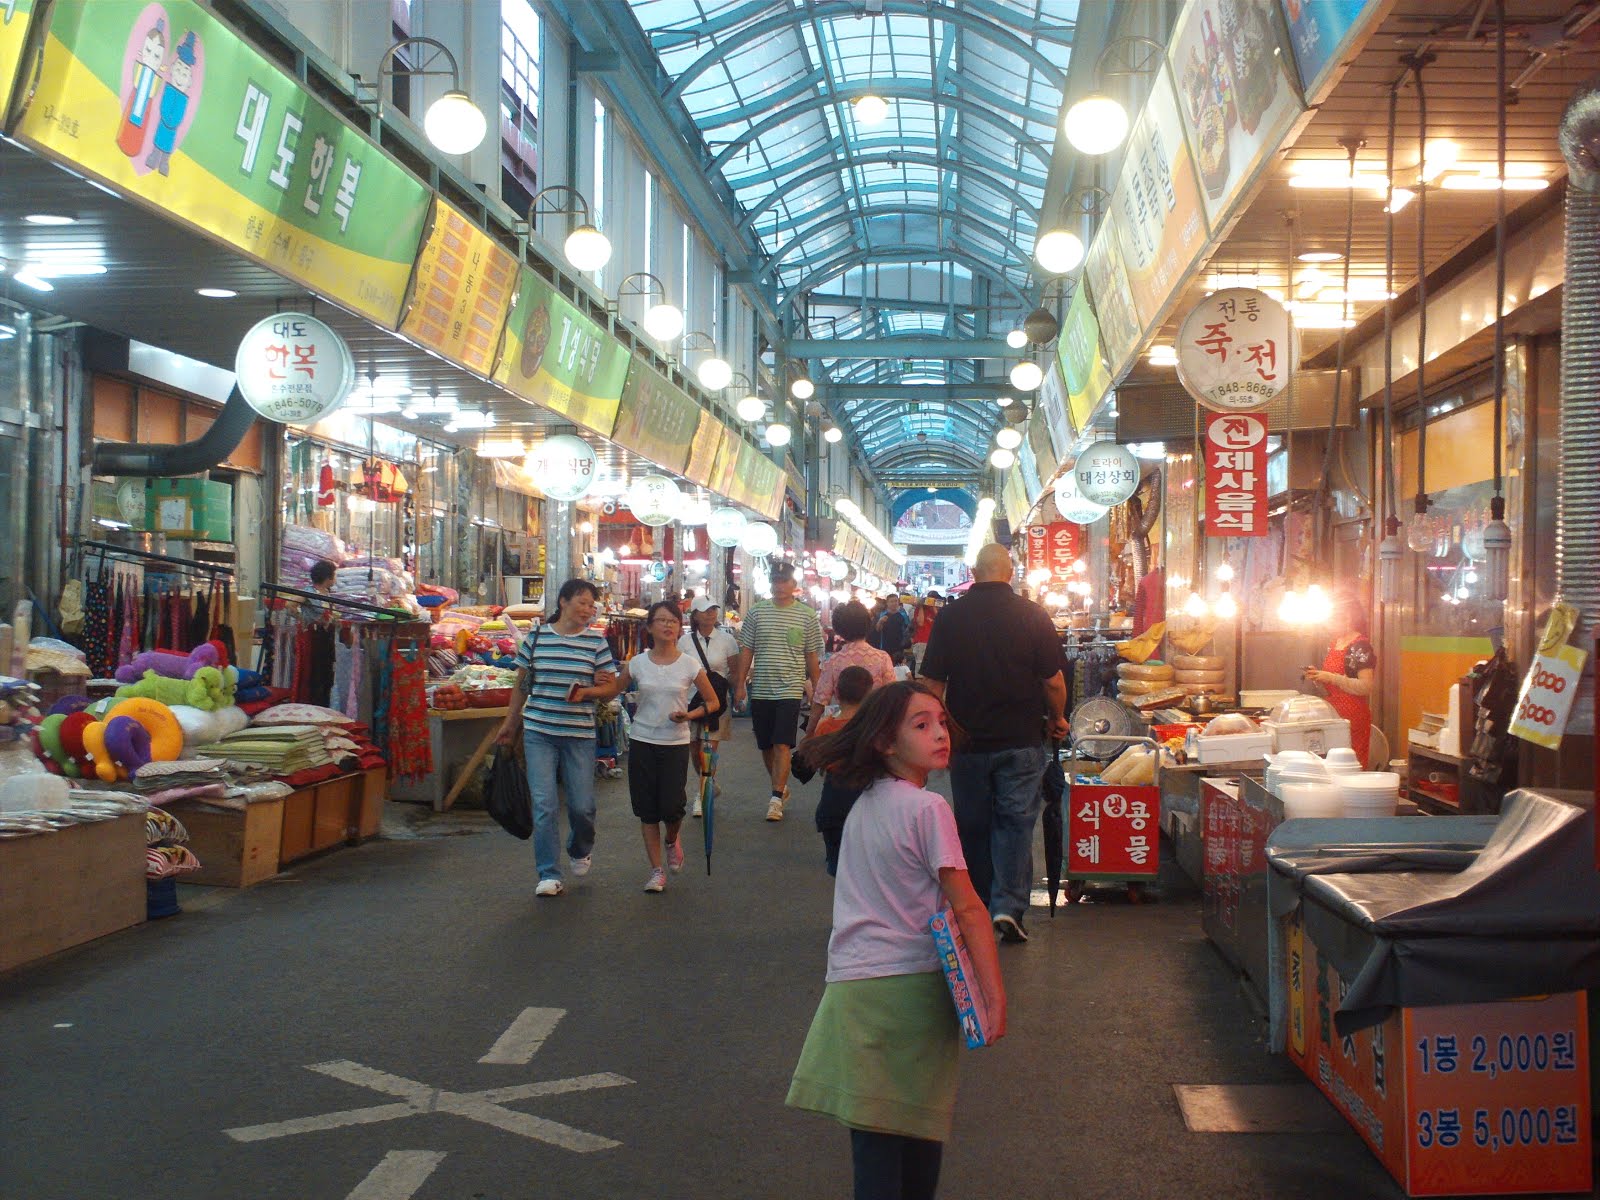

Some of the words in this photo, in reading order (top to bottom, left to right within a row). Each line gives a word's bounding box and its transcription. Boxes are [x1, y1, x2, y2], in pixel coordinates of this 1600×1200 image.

[235, 83, 362, 234] 대도한복
[1218, 298, 1260, 322] 전통
[273, 322, 307, 338] 대도
[265, 344, 318, 380] 한복
[1223, 418, 1251, 446] 전
[1080, 469, 1135, 485] 대성상회
[1091, 457, 1122, 468] 트라이
[1213, 451, 1258, 531] 제사음식
[1053, 529, 1075, 581] 손두부
[1106, 796, 1123, 814] 냉
[1418, 1036, 1458, 1073] 1봉
[1471, 1031, 1576, 1079] 2,000원
[1418, 1108, 1462, 1148] 3봉
[1474, 1104, 1578, 1153] 5,000원
